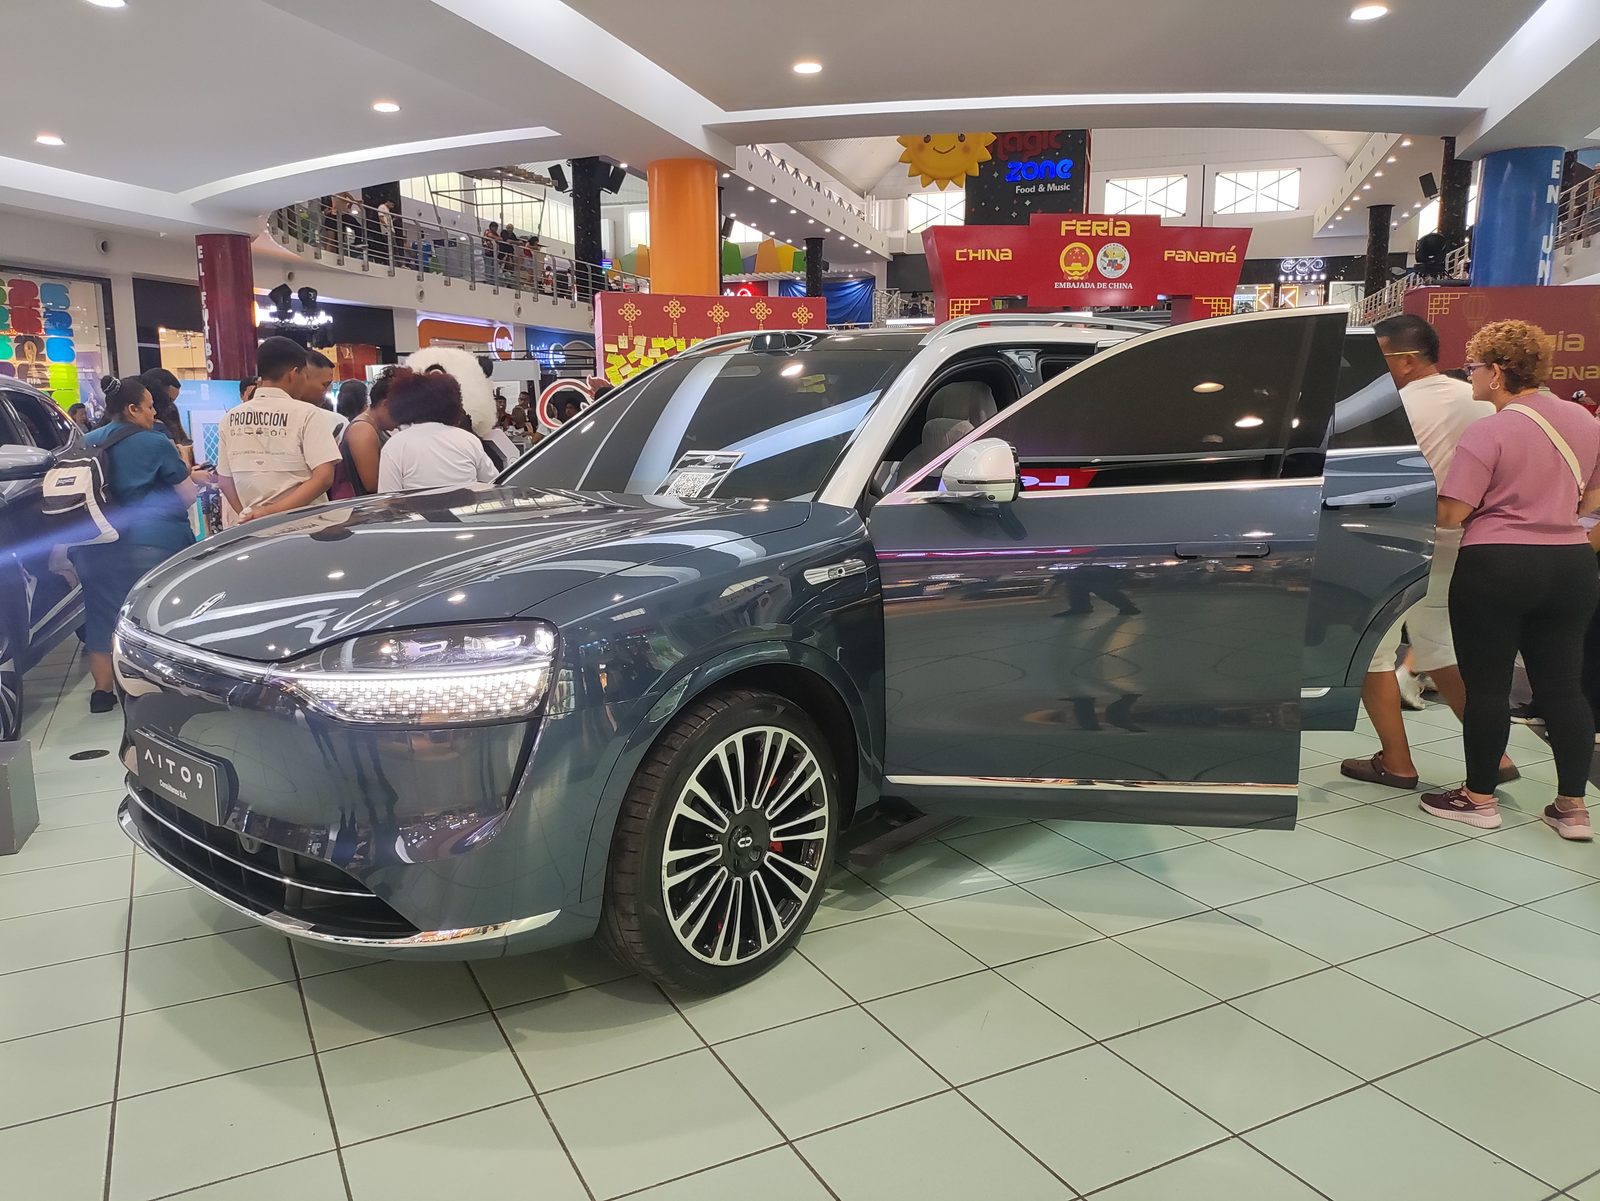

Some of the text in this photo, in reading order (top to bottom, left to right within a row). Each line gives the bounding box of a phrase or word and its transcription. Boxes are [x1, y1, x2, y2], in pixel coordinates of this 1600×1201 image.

[985, 131, 1063, 161] agic
[1005, 159, 1073, 182] zone
[1015, 182, 1071, 194] Food & Music
[1108, 282, 1134, 290] CHINA
[26, 377, 42, 385] FIFA
[229, 409, 289, 428] PRODUCCIÓN
